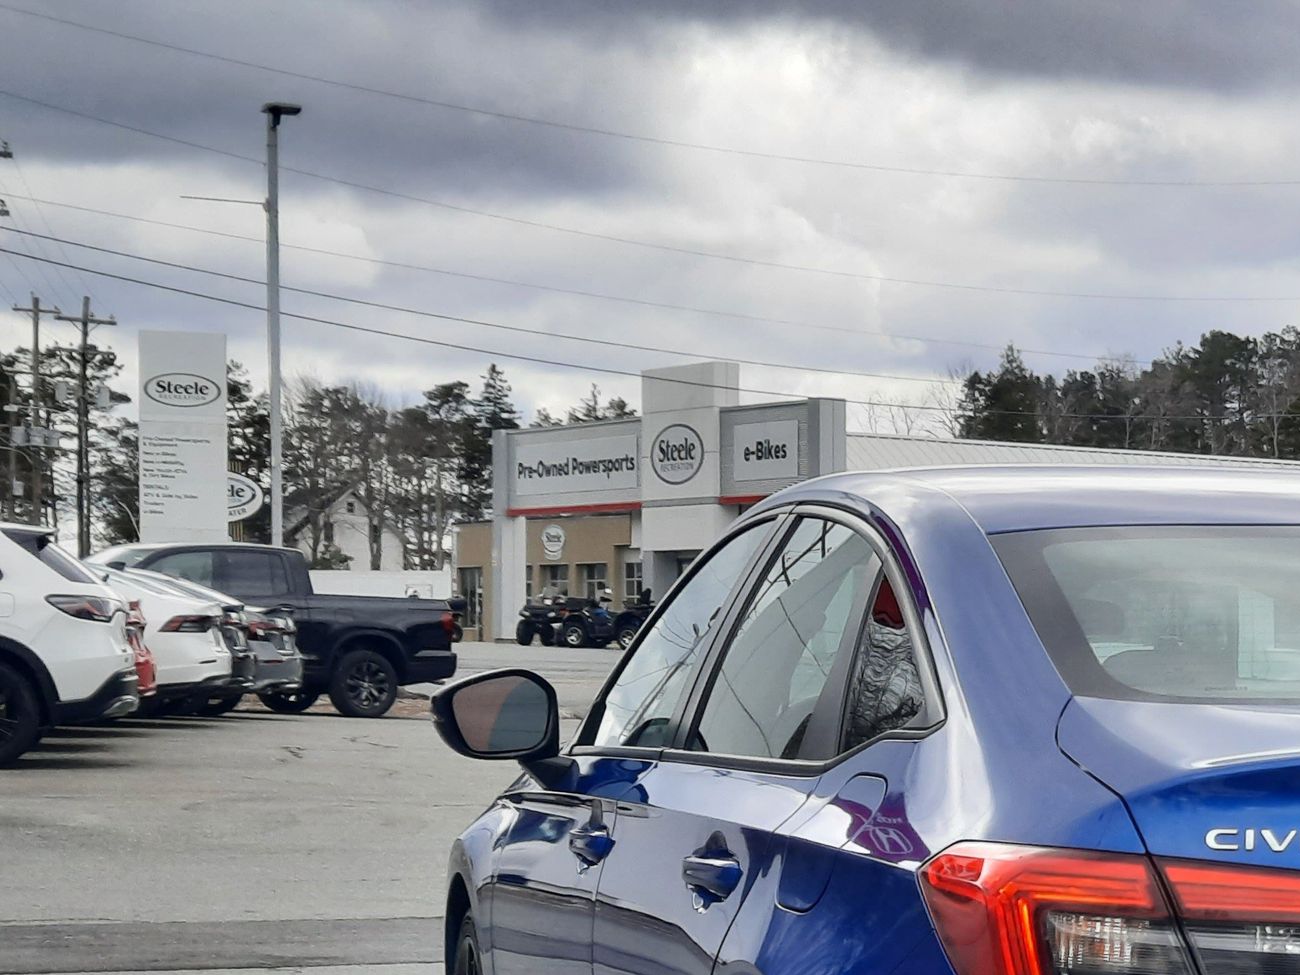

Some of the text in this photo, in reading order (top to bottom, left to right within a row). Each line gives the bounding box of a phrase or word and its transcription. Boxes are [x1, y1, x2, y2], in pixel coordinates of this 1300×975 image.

[155, 380, 209, 395] Steele
[658, 438, 696, 463] Steele
[743, 439, 787, 461] e-Bikes
[518, 454, 635, 479] Pre-Owned Powersports
